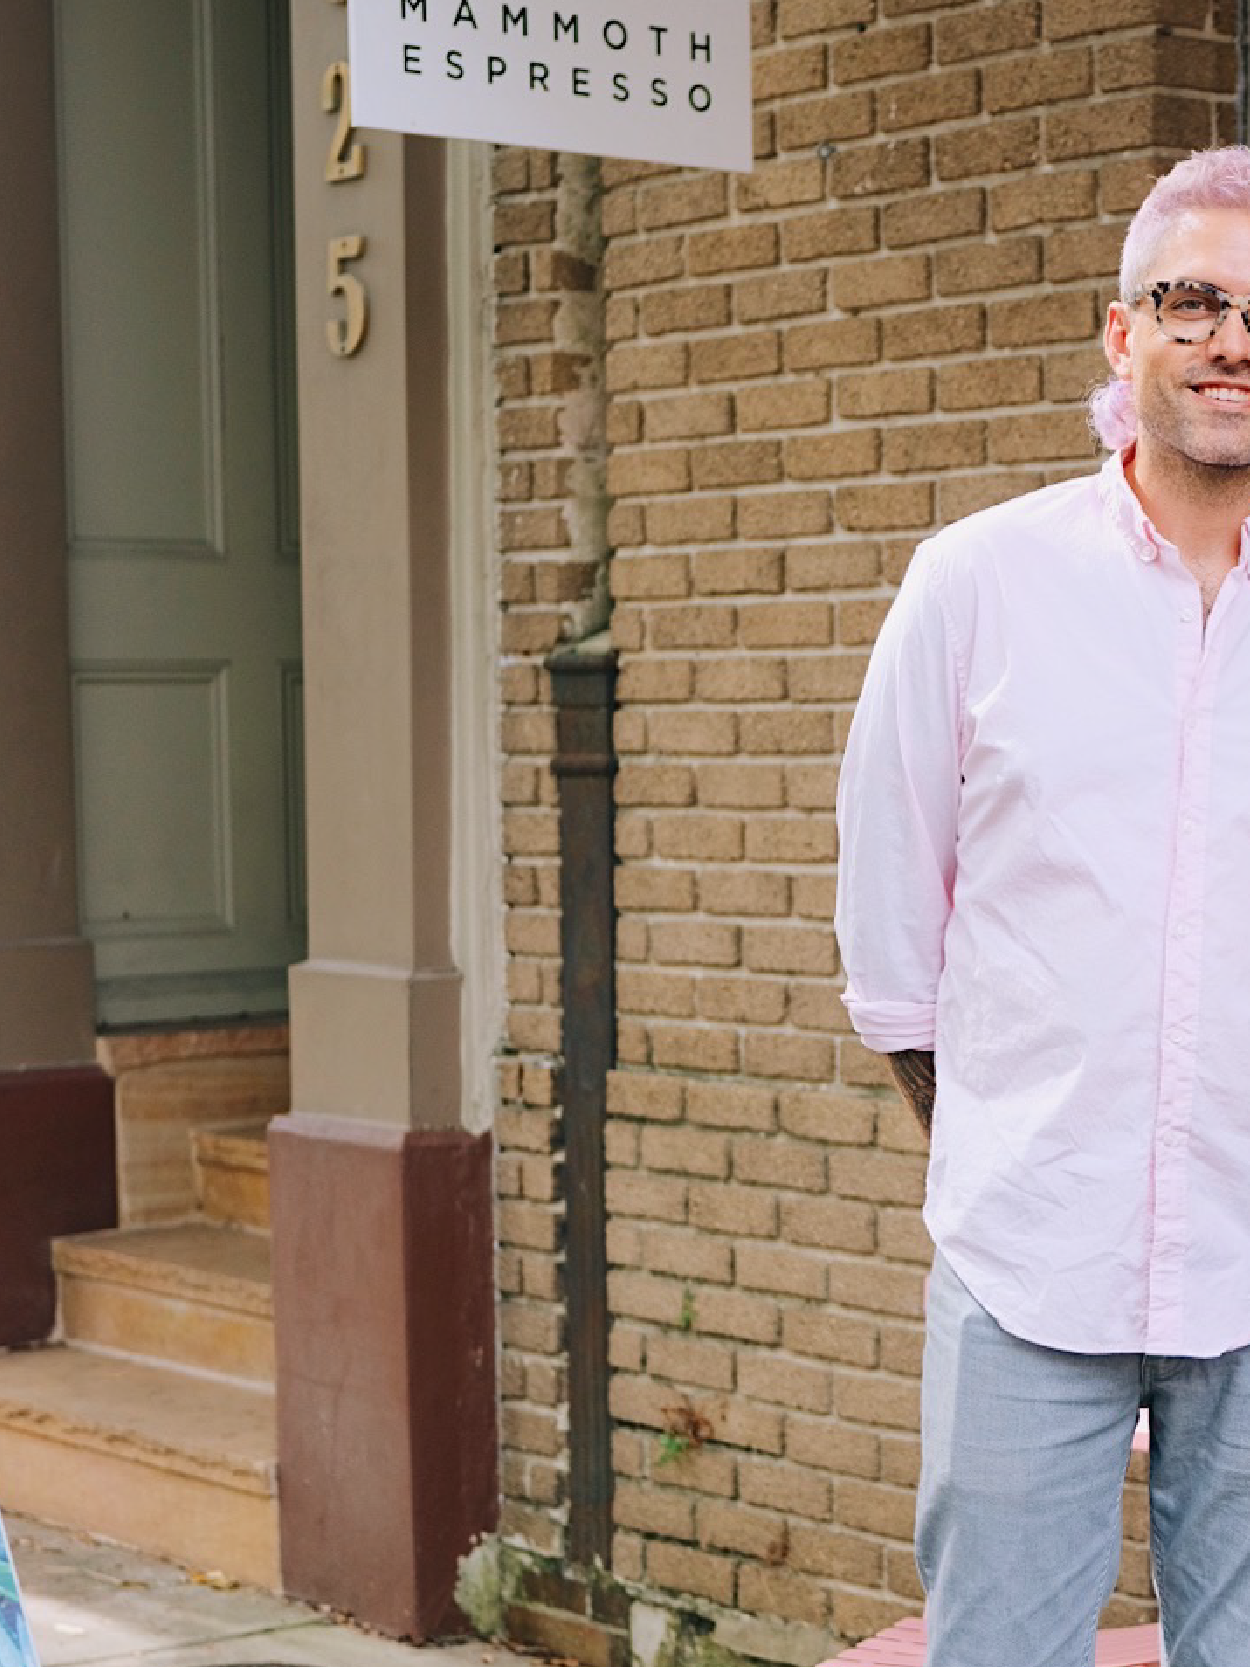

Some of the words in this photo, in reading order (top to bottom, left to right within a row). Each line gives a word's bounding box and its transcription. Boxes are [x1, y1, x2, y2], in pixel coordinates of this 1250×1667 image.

[400, 0, 711, 63] MAMMOTH
[403, 43, 712, 113] ESPRESSO
[323, 0, 368, 358] 25
